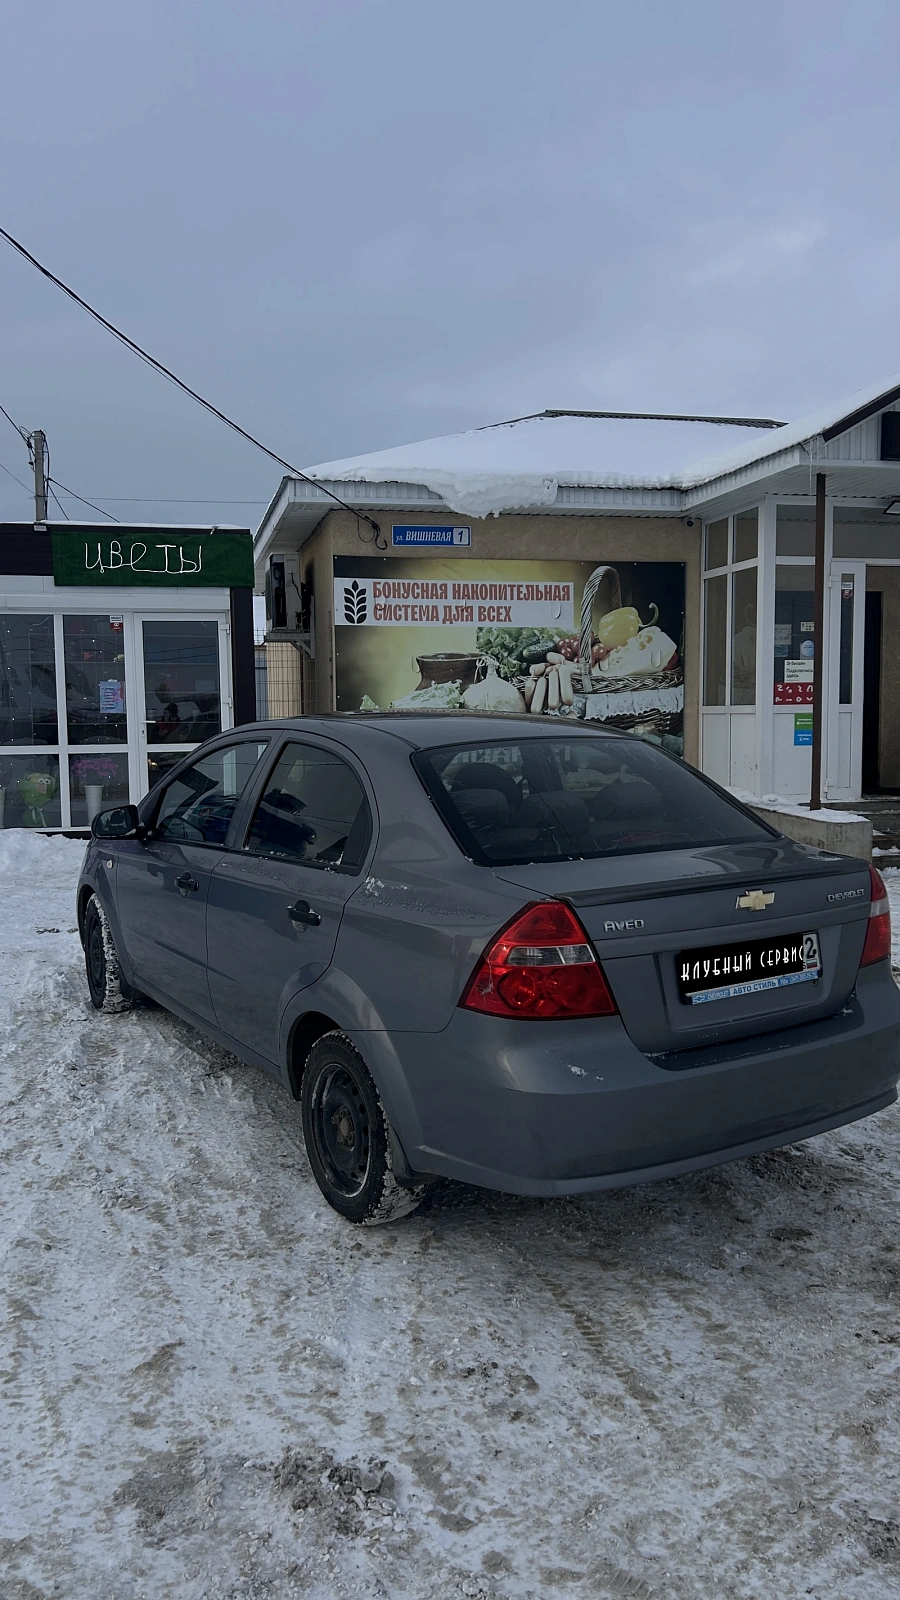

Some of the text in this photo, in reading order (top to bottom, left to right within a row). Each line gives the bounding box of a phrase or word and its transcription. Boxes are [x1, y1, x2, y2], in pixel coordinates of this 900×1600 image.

[405, 530, 452, 542] ВИШНЕВАЯ
[457, 530, 464, 543] 1
[372, 581, 571, 602] БОНУСНАЯ НАКОПИТЕЛЬНАЯ
[373, 603, 513, 625] СИСТЕМА ДЛЯ ВСЕХ
[827, 889, 865, 902] CHEVROLET
[603, 919, 645, 933] AVEO
[733, 979, 777, 996] АВТО СТИЛЬ
